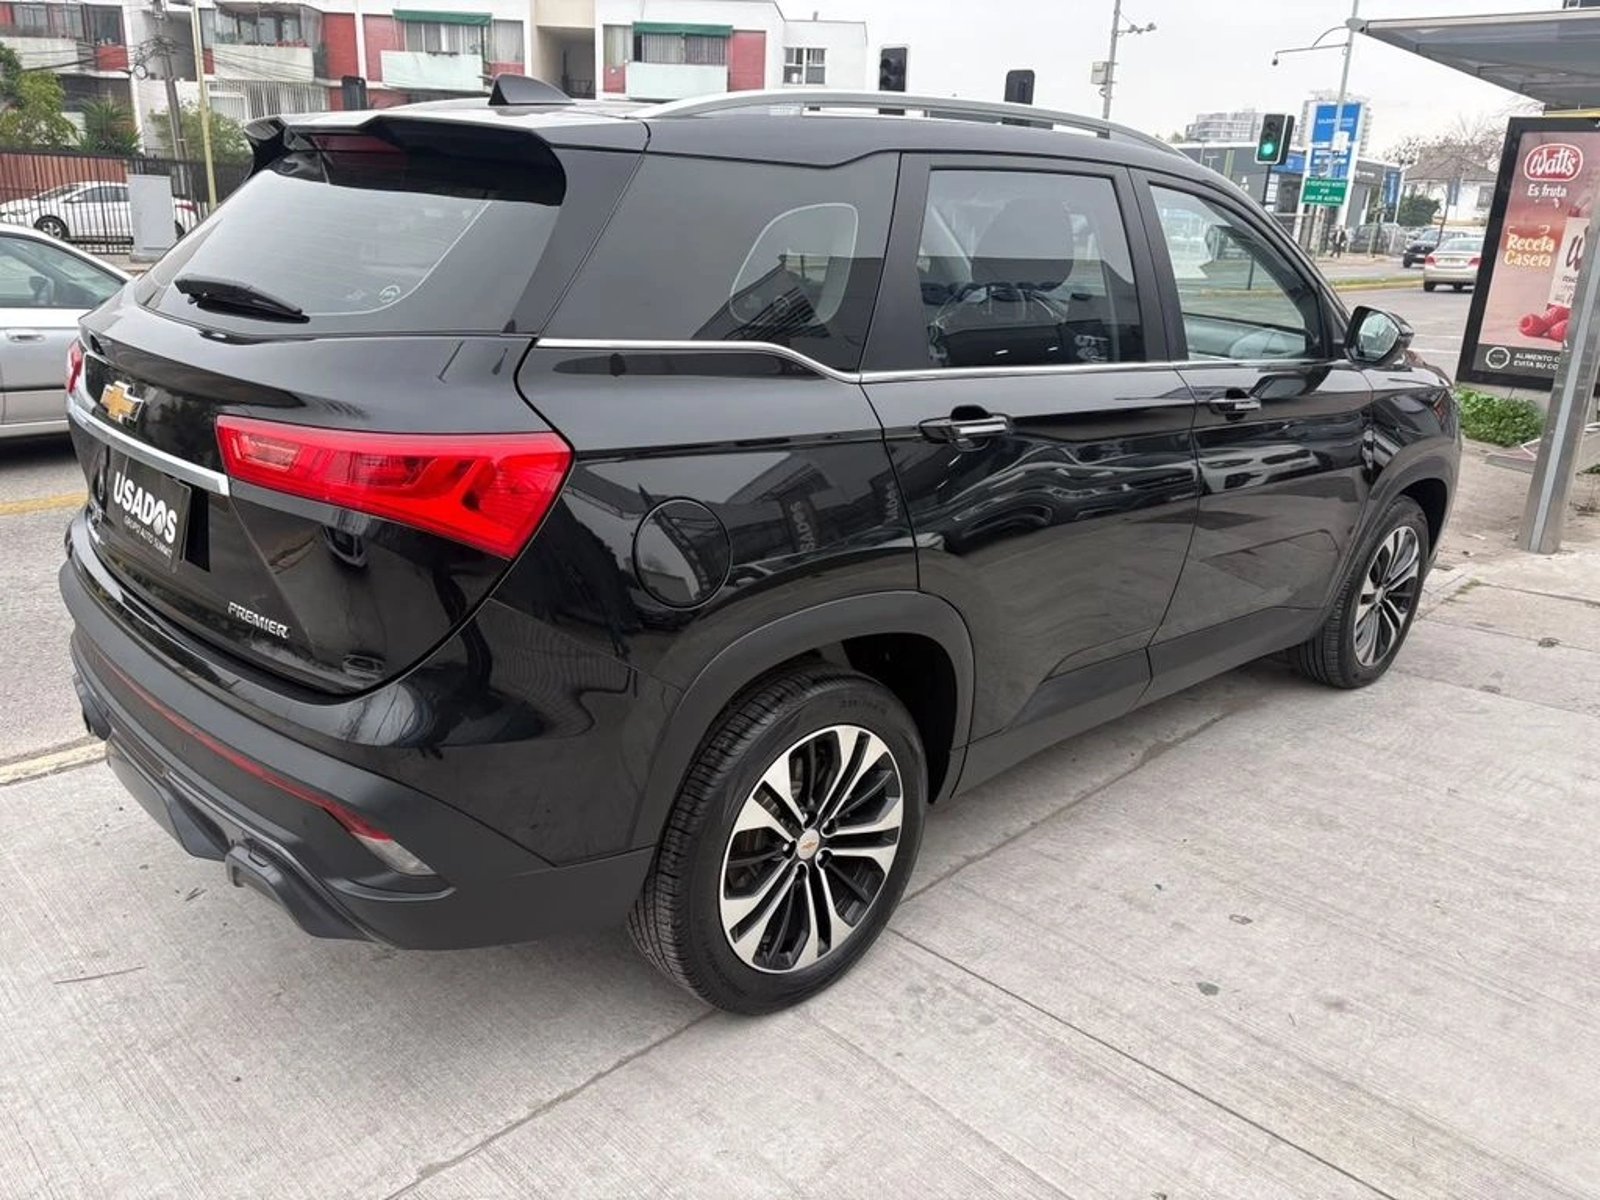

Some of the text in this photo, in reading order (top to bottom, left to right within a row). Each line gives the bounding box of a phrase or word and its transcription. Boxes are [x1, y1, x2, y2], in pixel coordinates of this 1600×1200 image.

[1527, 184, 1568, 197] Es fruta
[1506, 233, 1556, 253] Receta
[1503, 250, 1552, 267] Casera
[1513, 360, 1534, 368] EVITA
[1515, 352, 1552, 361] ALIMENTO
[113, 471, 178, 544] USADOS
[227, 601, 290, 639] PREMIER
